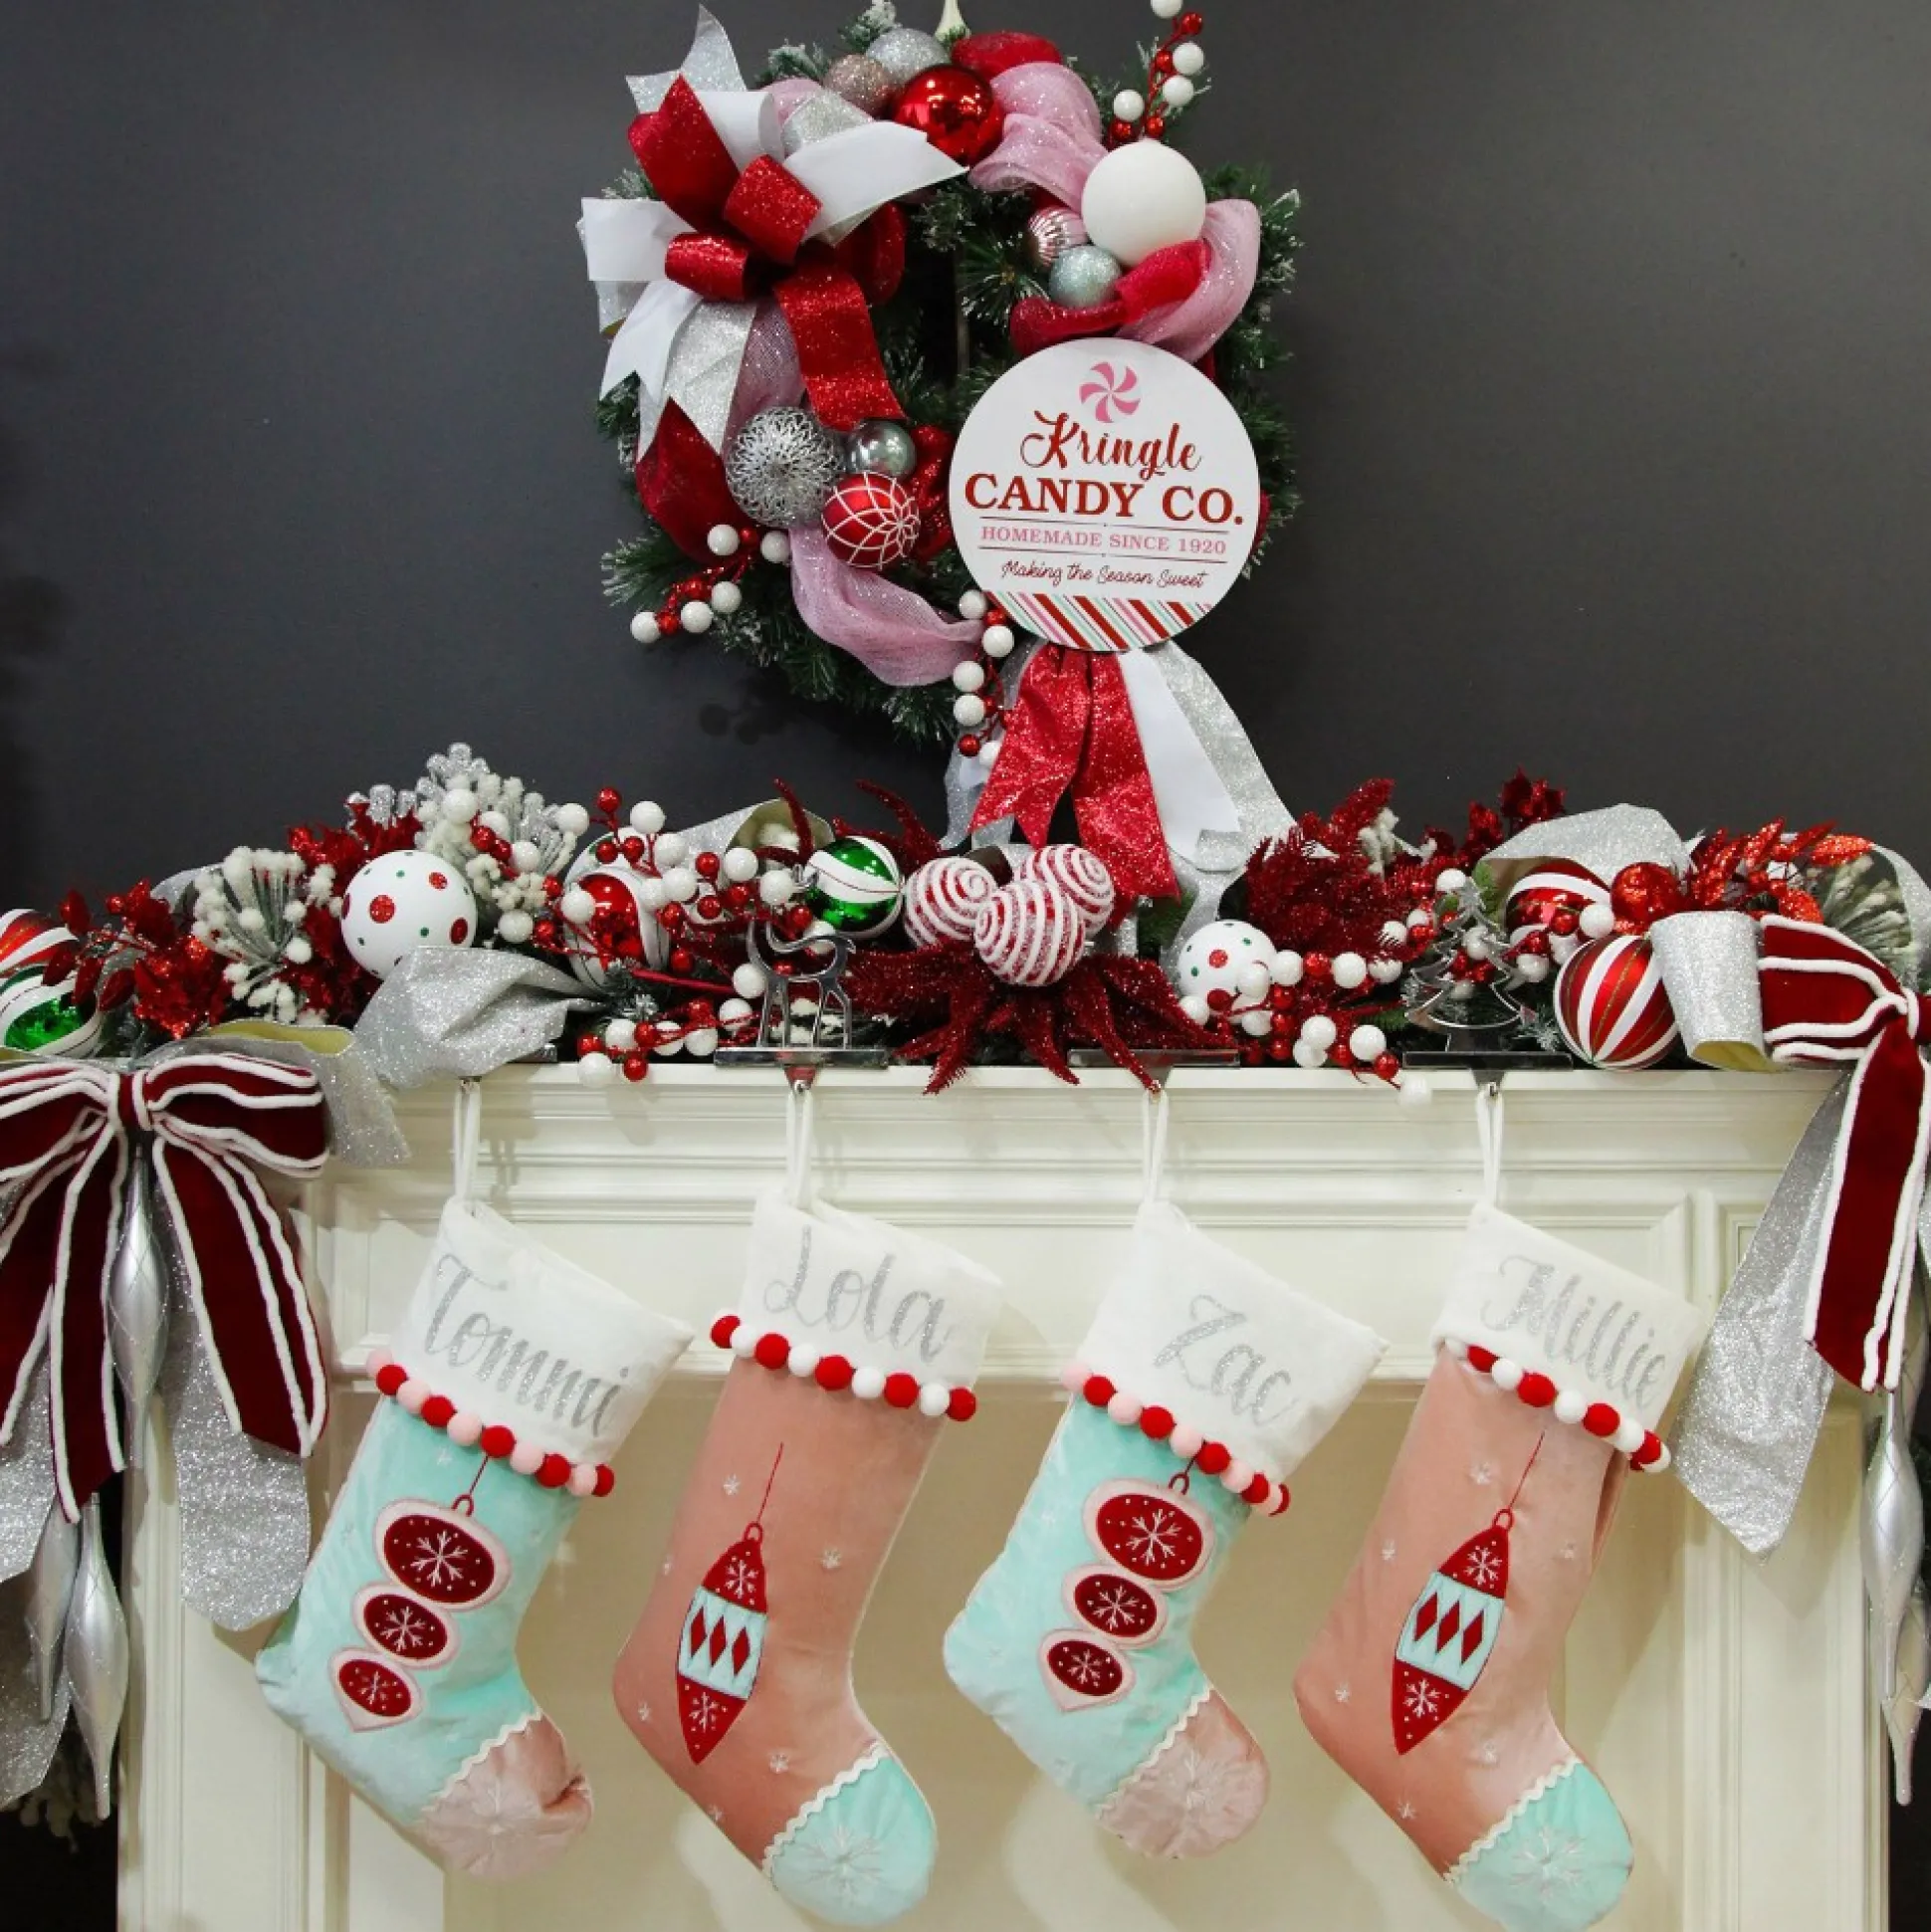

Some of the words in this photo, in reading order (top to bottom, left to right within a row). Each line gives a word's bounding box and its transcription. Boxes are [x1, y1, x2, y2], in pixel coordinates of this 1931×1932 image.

[1020, 409, 1202, 480] Kringle
[965, 473, 1144, 517] CANDY
[1162, 486, 1243, 525] CO.
[980, 526, 1102, 546] HOMEMADE
[1109, 535, 1170, 551] SINCE
[1178, 537, 1226, 554] 1920
[1001, 559, 1062, 585] Making
[1067, 562, 1093, 580] the
[1097, 565, 1154, 585] Season
[1157, 570, 1208, 588] Sweet
[425, 1254, 631, 1435] Tommi
[764, 1226, 956, 1362] Lola
[1481, 1255, 1666, 1409] Millie
[1154, 1294, 1298, 1427] Zac
